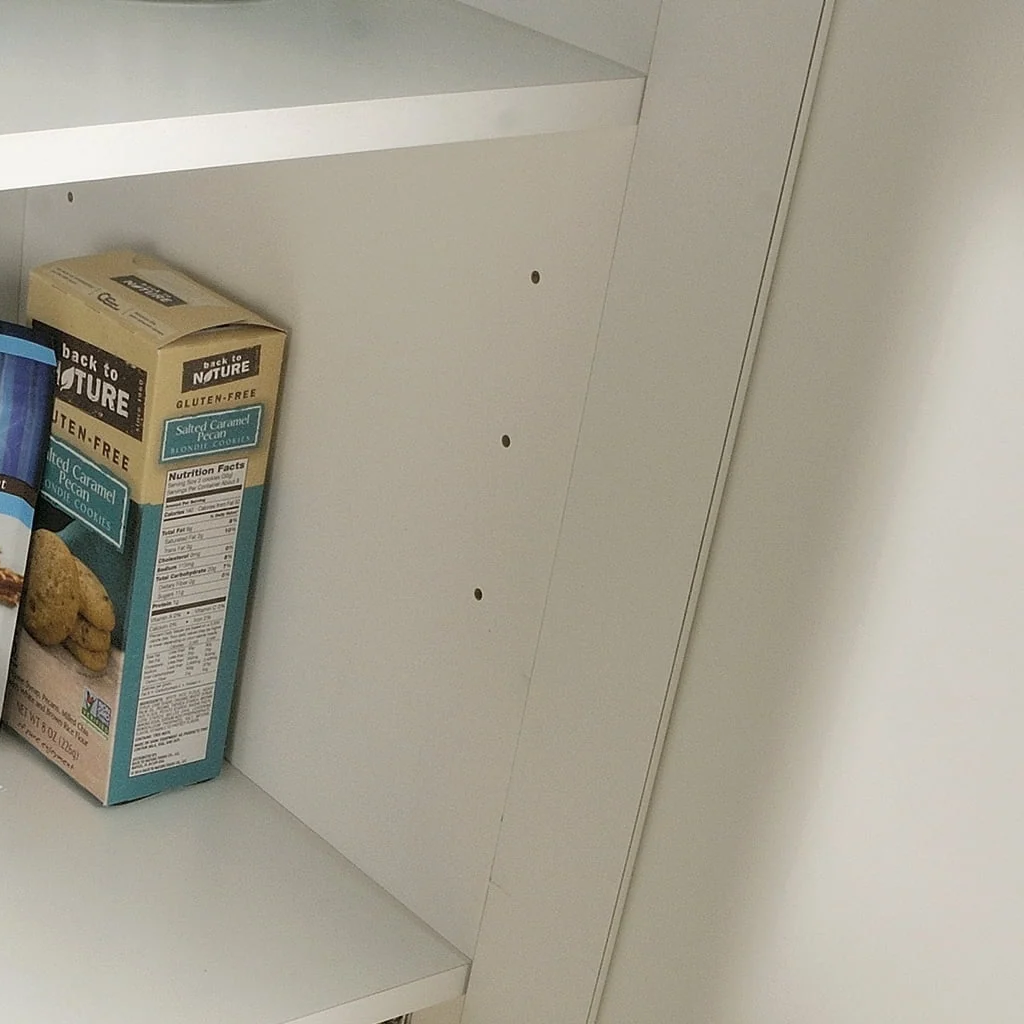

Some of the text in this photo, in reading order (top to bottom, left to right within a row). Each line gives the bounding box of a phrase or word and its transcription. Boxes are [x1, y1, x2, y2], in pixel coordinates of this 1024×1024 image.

[62, 342, 118, 381] back to
[203, 354, 242, 369] back to
[176, 388, 256, 409] GLUTEN-FREE
[175, 414, 251, 436] Salted Caramel
[197, 430, 226, 442] Pecan
[168, 462, 245, 480] Nutrition Facts
[59, 471, 90, 503] Pecan
[72, 463, 116, 505] Caramel
[75, 498, 112, 532] COOKIES
